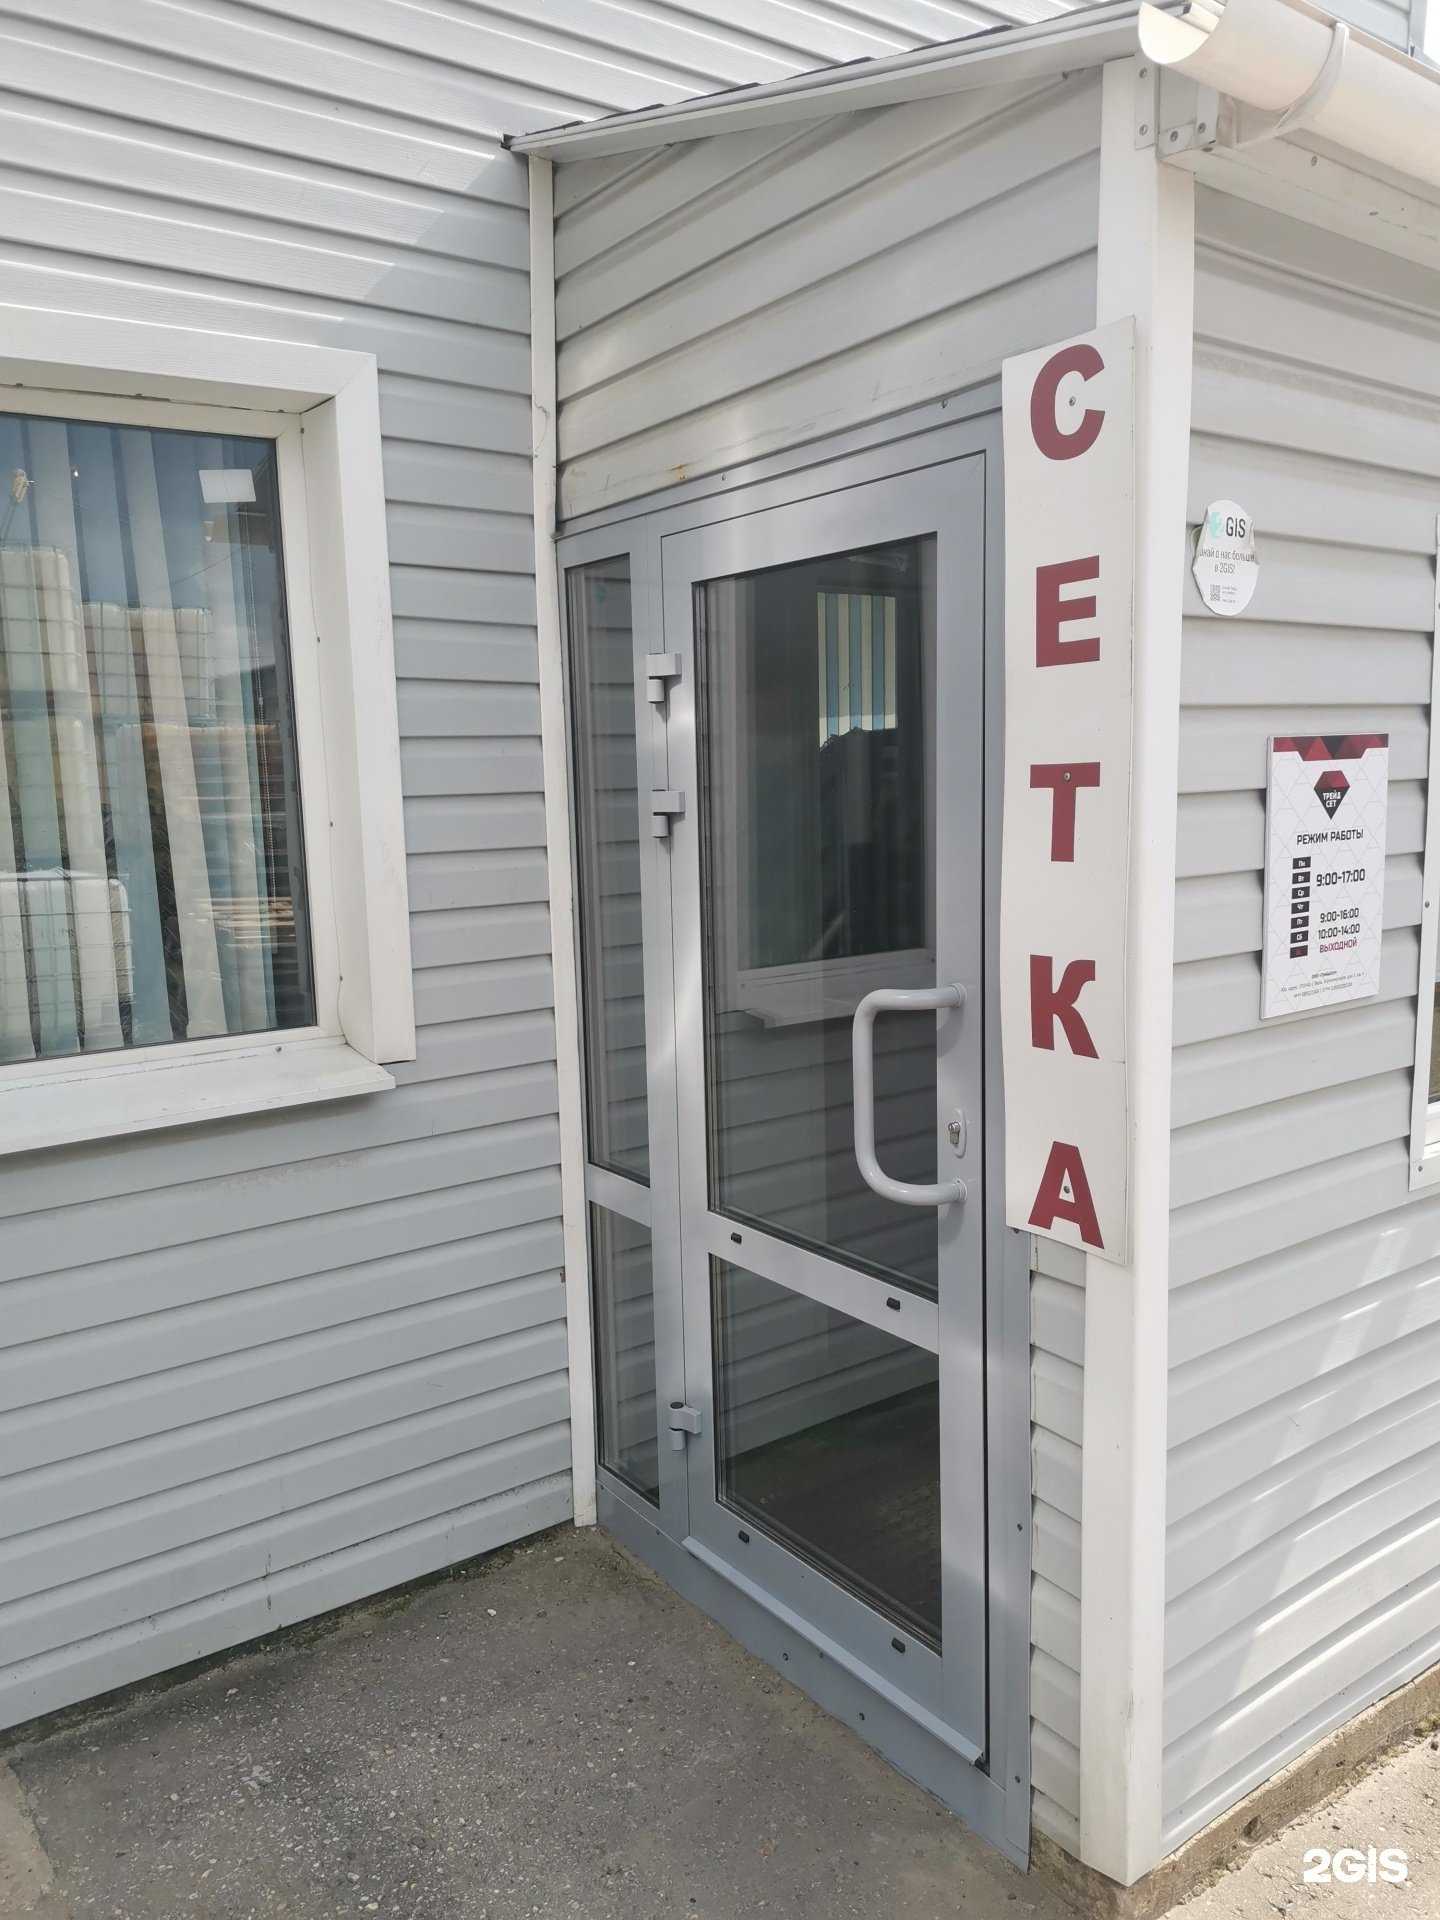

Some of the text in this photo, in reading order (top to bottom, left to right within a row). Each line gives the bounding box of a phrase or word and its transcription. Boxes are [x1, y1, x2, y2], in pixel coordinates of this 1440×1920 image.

[1028, 343, 1106, 1251] СЕТКА
[1323, 789, 1341, 801] ТРЕЙД
[1326, 800, 1337, 808] СЕТ
[1296, 829, 1364, 846] РЕЖИМ РАБОТЫ
[1316, 868, 1366, 887] 9:00-17:00
[1320, 907, 1360, 923] 9:00-16:00
[1318, 923, 1361, 940] 10:00-14:00
[1319, 937, 1359, 953] ВЫХОДНОЙ
